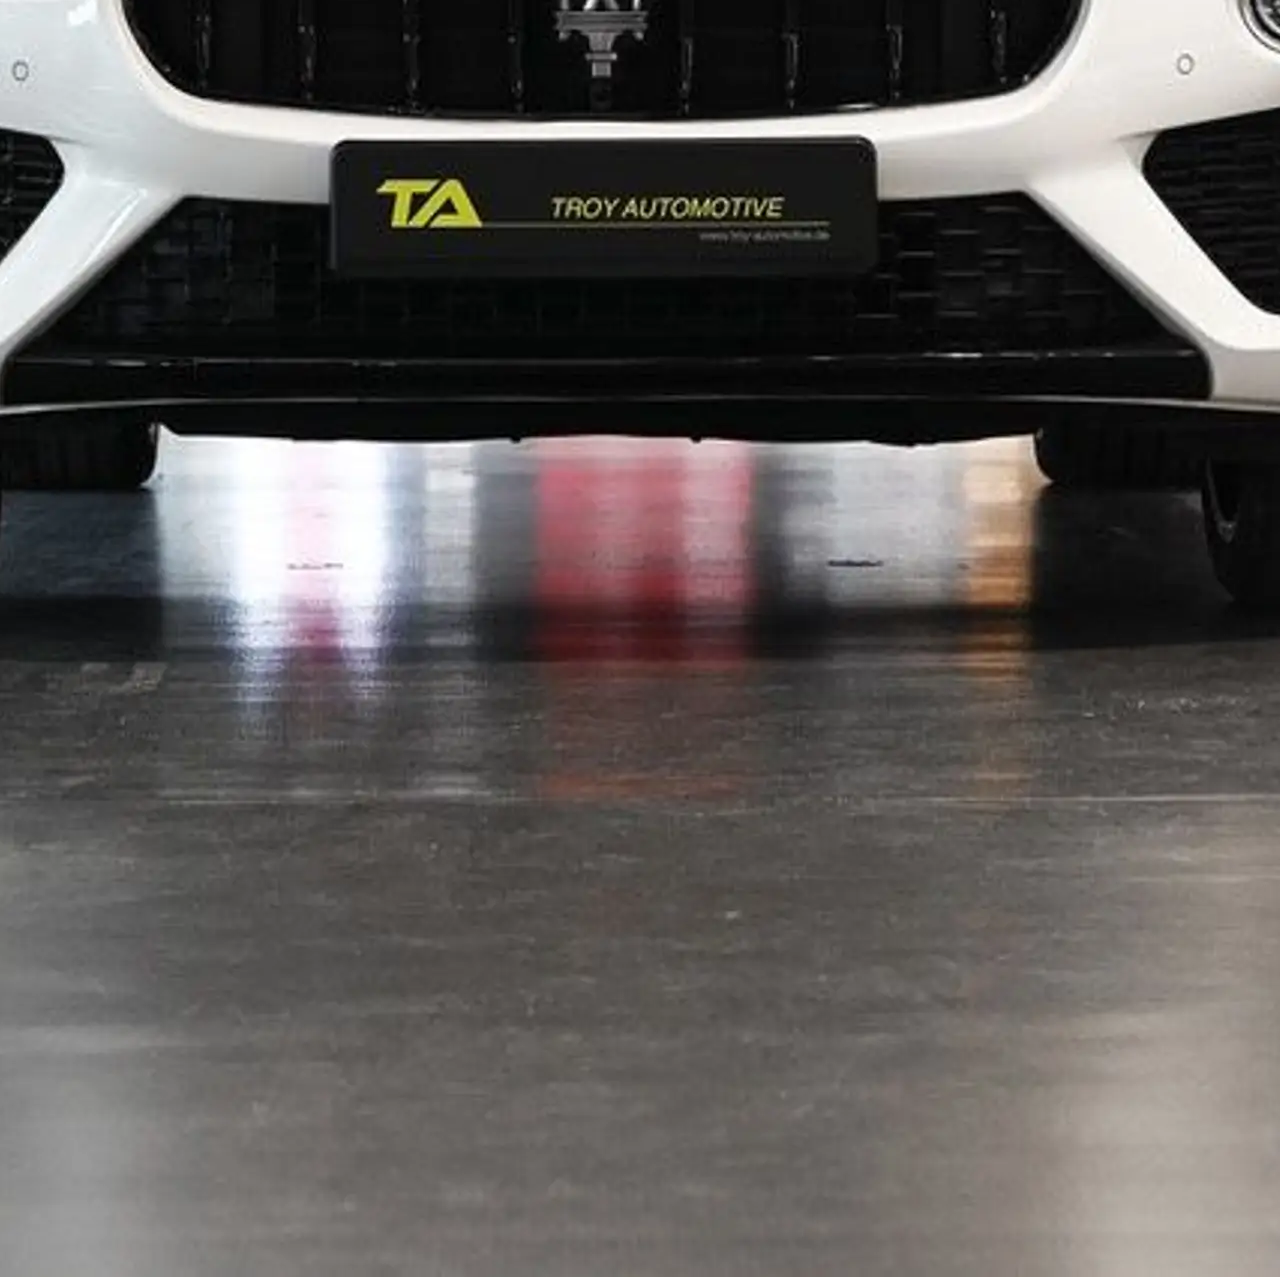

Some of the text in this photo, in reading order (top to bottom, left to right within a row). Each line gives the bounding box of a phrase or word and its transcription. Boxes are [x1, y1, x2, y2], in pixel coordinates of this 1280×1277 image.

[376, 178, 483, 228] TA
[551, 196, 786, 219] TROY AUTOMOTIVE
